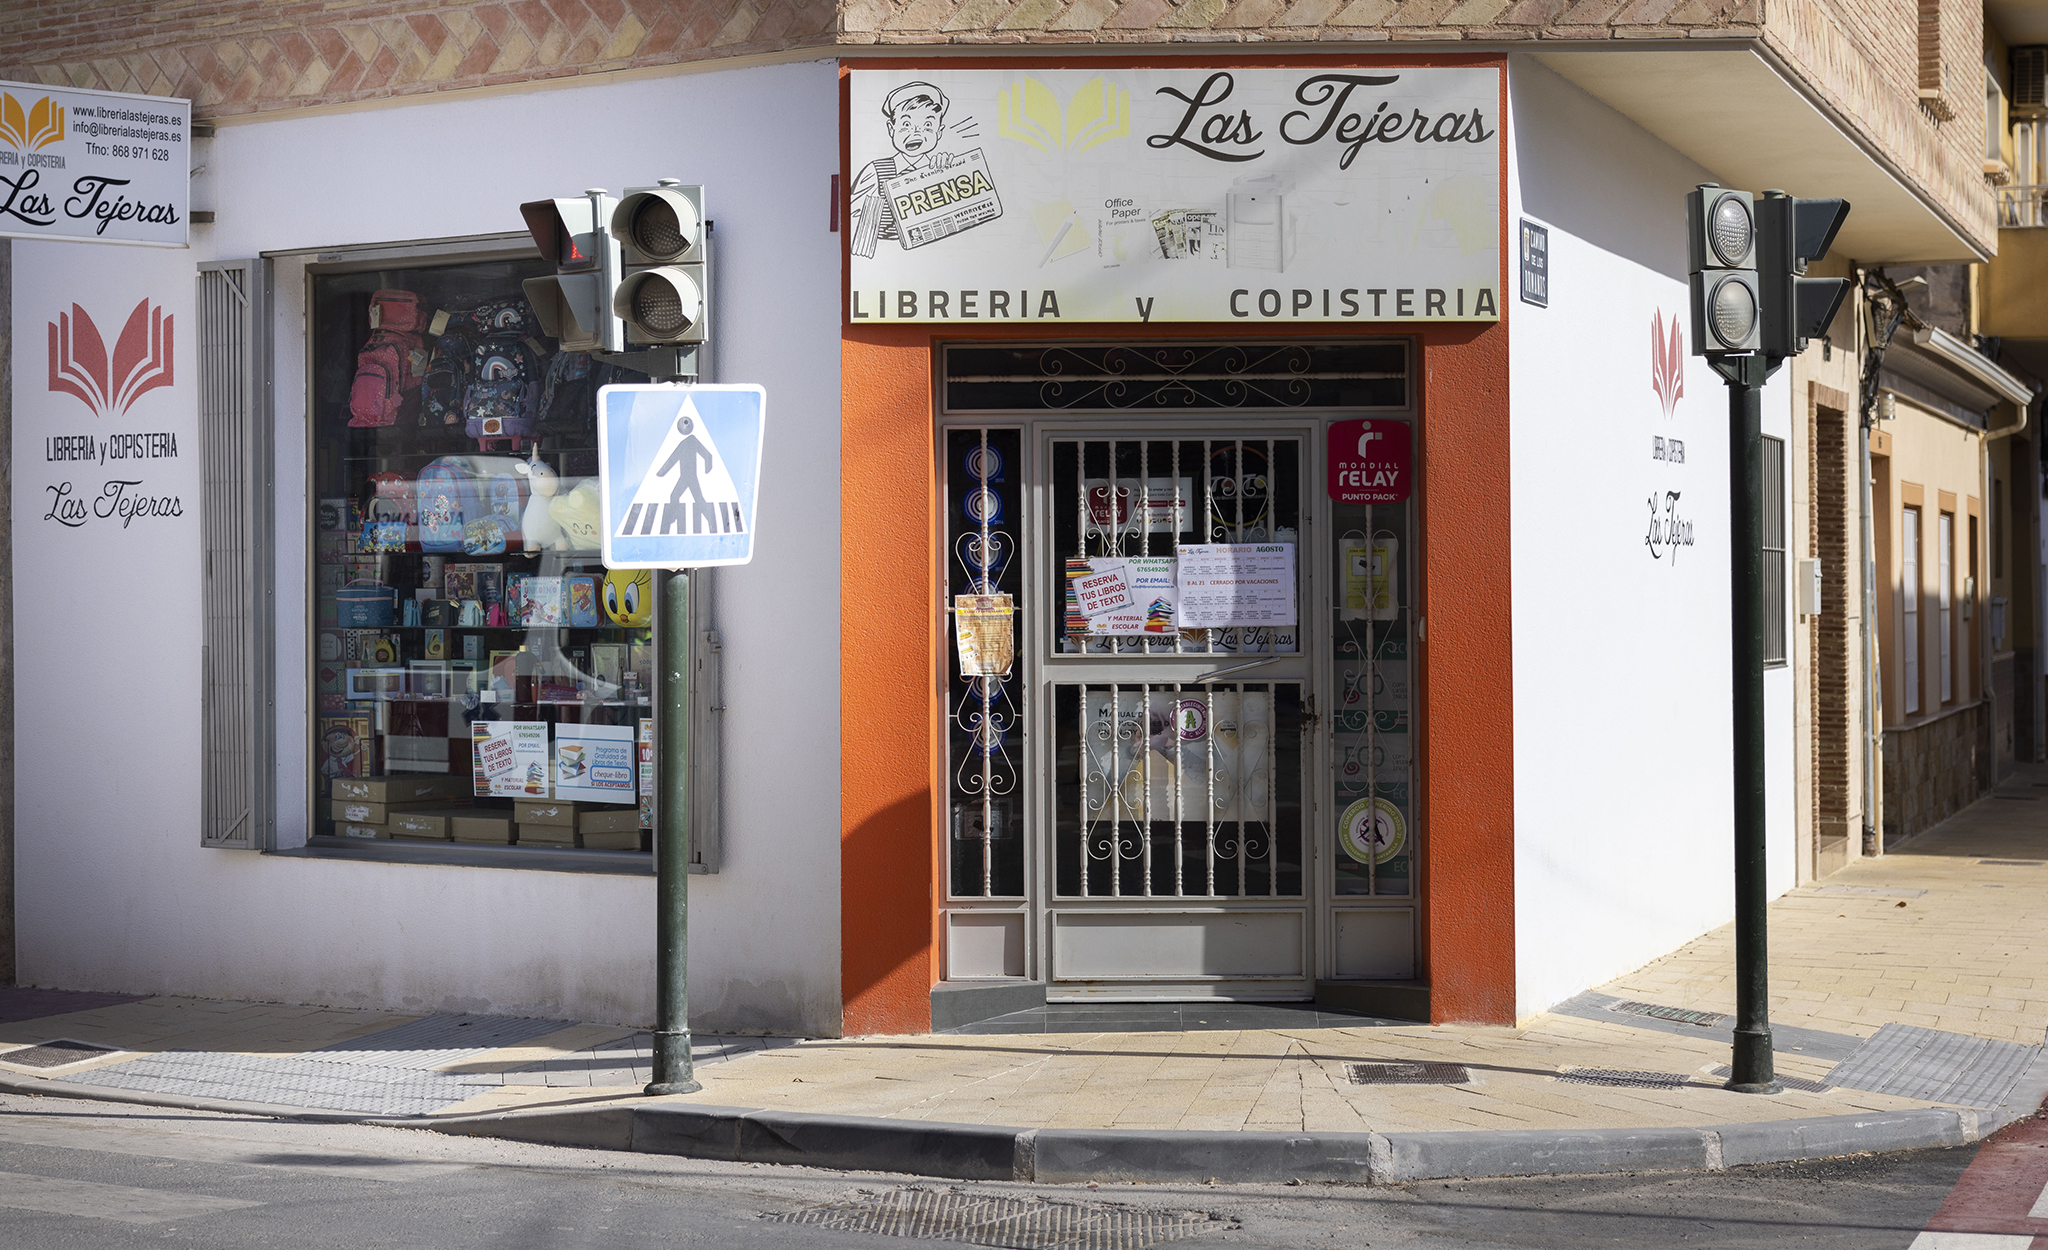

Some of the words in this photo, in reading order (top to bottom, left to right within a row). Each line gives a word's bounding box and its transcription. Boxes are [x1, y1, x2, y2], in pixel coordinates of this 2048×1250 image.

[73, 106, 182, 126] www.librerialastejeras.es
[1146, 72, 1265, 162] Las
[1280, 74, 1494, 170] Tejeras
[73, 121, 182, 142] info@librerialastejeras.es
[86, 142, 109, 156] Tfno:
[113, 146, 130, 158] 868
[132, 147, 148, 159] 971
[152, 149, 169, 161] 628
[21, 156, 26, 169] y
[28, 154, 66, 169] COPISTERIA
[0, 169, 56, 226] Las
[64, 176, 180, 236] Tejeras
[894, 170, 993, 220] PRENSA
[1105, 198, 1133, 208] Office
[1112, 208, 1141, 218] Paper
[852, 290, 1060, 318] LIBRERIA
[1135, 297, 1154, 322] y
[1229, 288, 1497, 318] COPISTERIA
[46, 436, 95, 461] LIBRERIA
[100, 442, 107, 466] y
[110, 433, 178, 459] COPISTERIA
[44, 482, 88, 528] Las
[94, 480, 183, 529] Tejeras
[1645, 491, 1662, 559] Las
[1664, 491, 1694, 566] Tejeras
[1080, 590, 1096, 601] TUS
[1098, 582, 1126, 596] LIBROS
[1082, 574, 1118, 590] RESERVA
[1087, 601, 1098, 610] DE
[1099, 594, 1124, 607] TEXTO
[483, 754, 494, 763] TUS
[495, 747, 512, 759] LIBROS
[484, 739, 507, 753] RESERVA
[488, 763, 495, 772] DE
[496, 758, 512, 768] TEXTO
[594, 770, 627, 779] cheque-libro
[1343, 803, 1364, 829] COMERCIO
